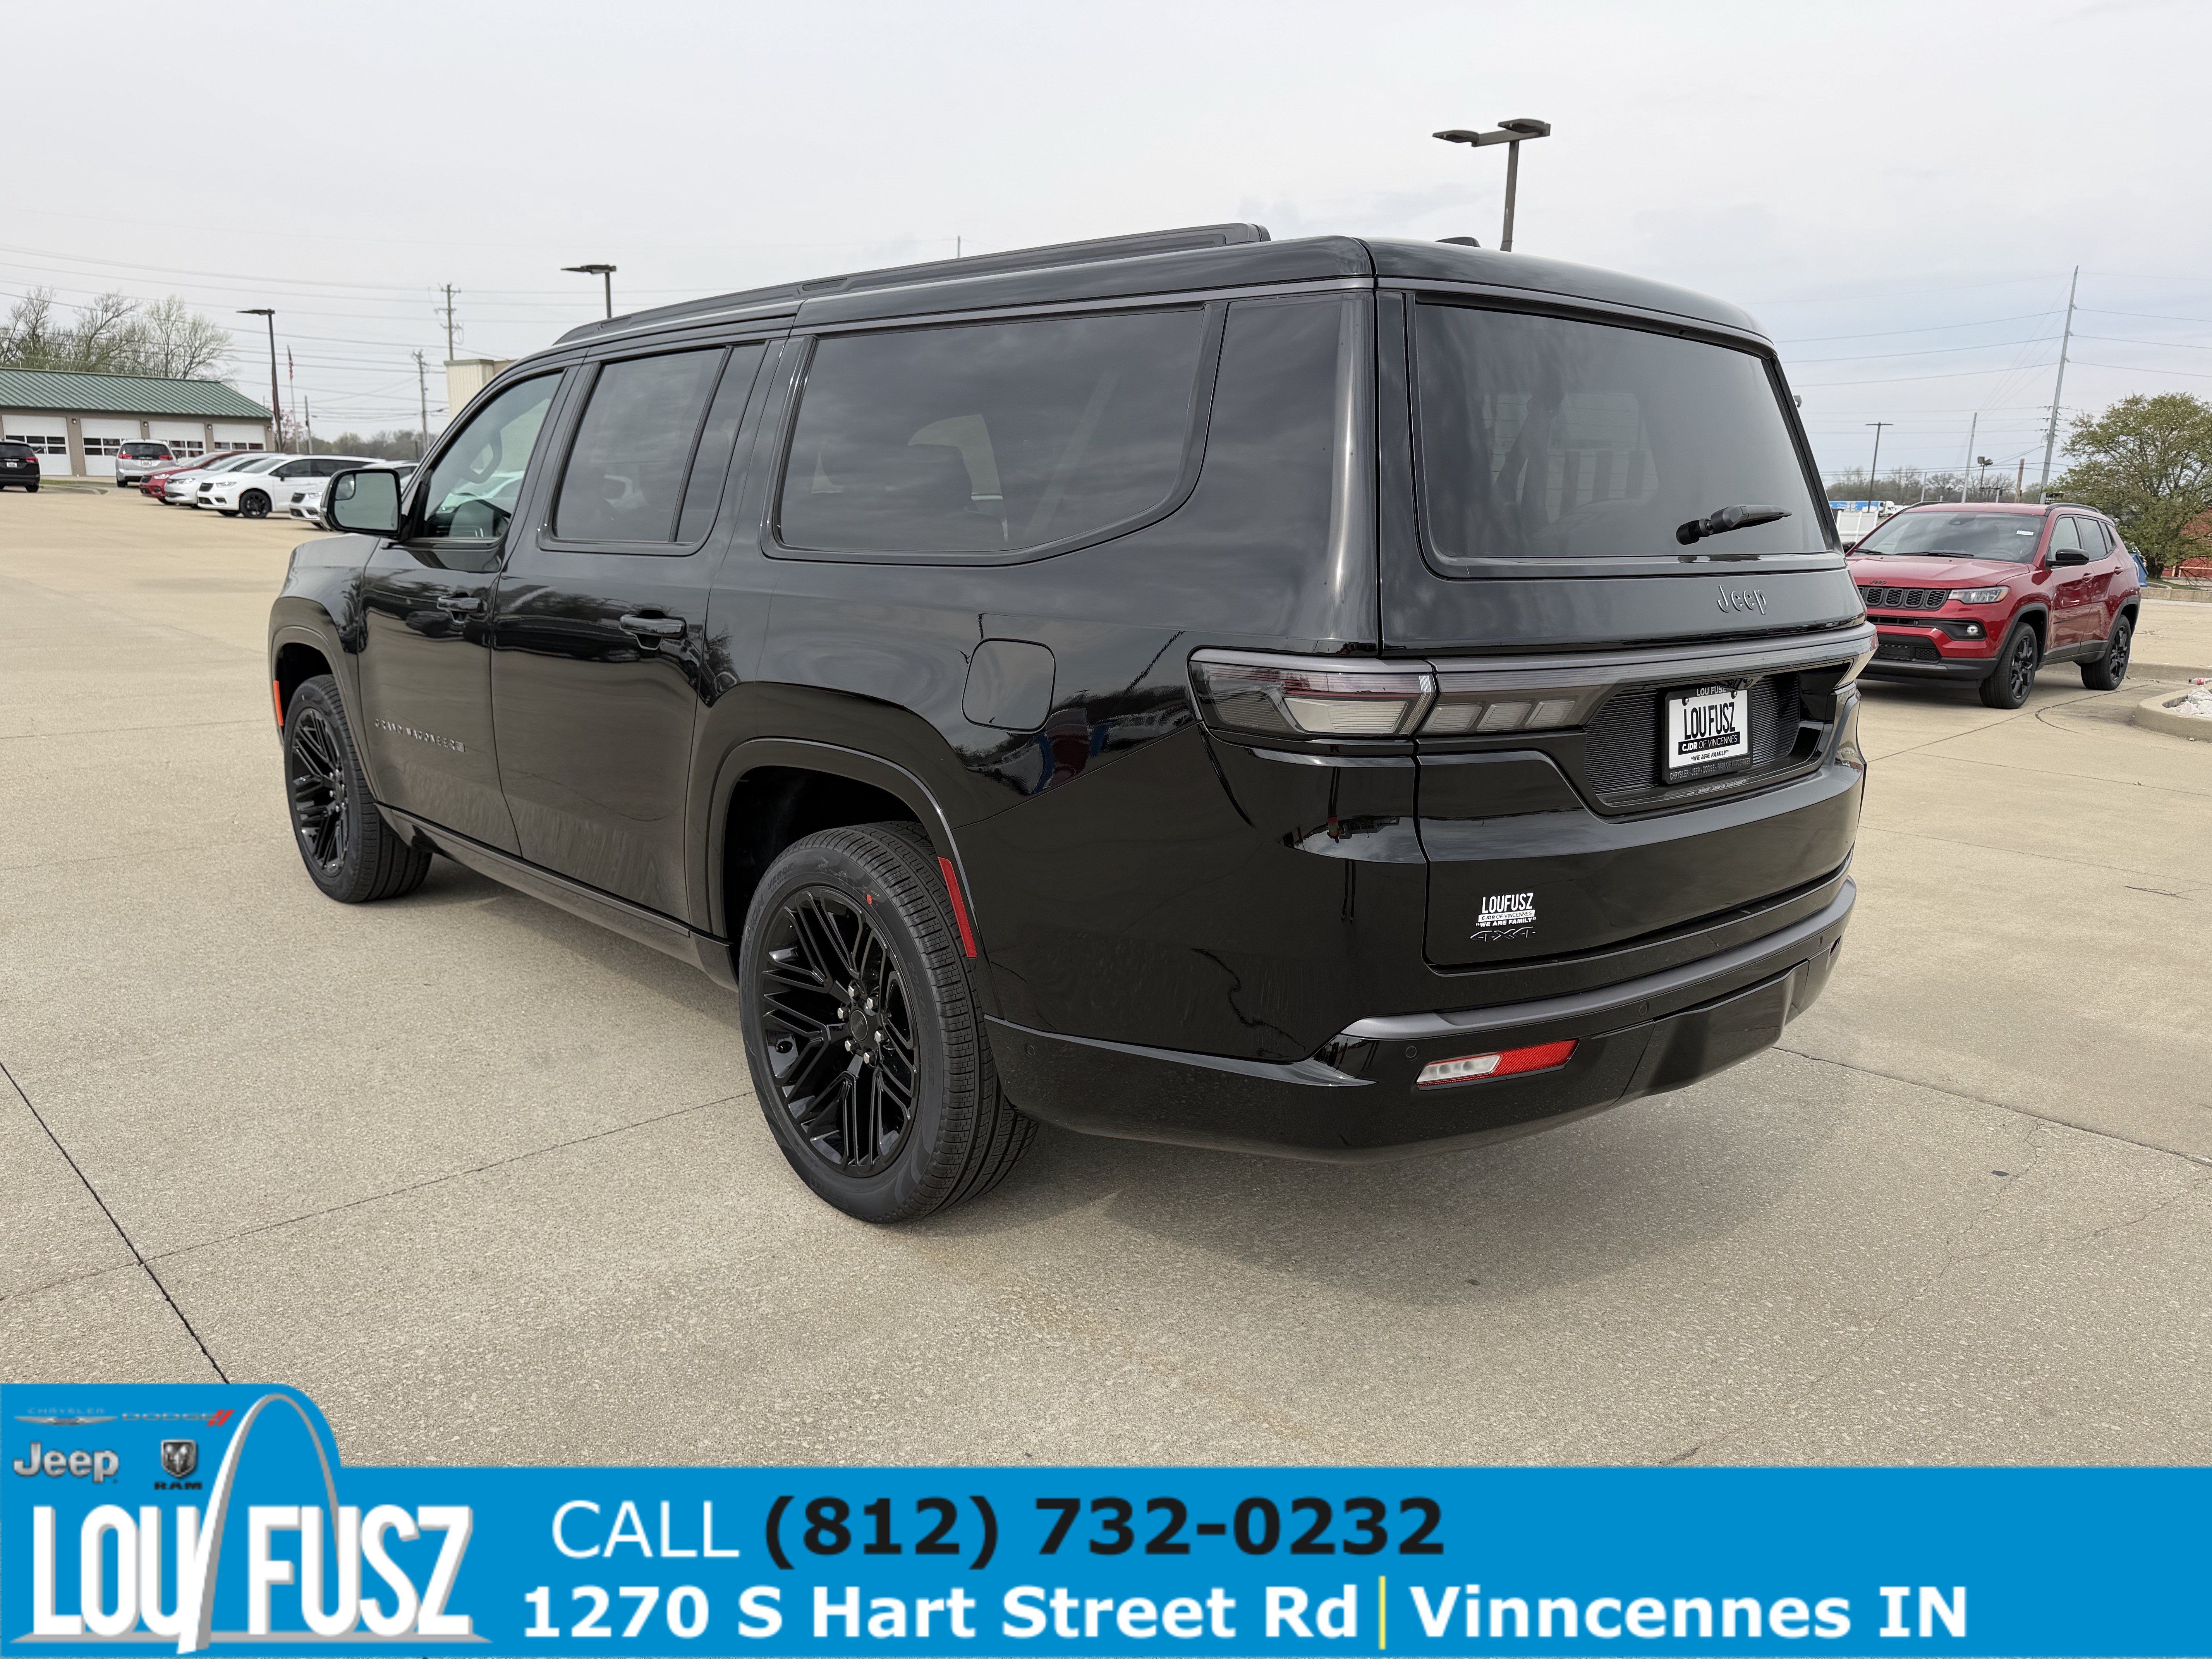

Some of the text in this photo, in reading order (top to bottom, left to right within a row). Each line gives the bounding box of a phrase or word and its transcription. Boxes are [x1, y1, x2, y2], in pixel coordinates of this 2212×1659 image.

[1717, 585, 1766, 615] Jeep
[1697, 687, 1709, 696] LOU
[1682, 734, 1737, 752] CJDR OF VINCENNES
